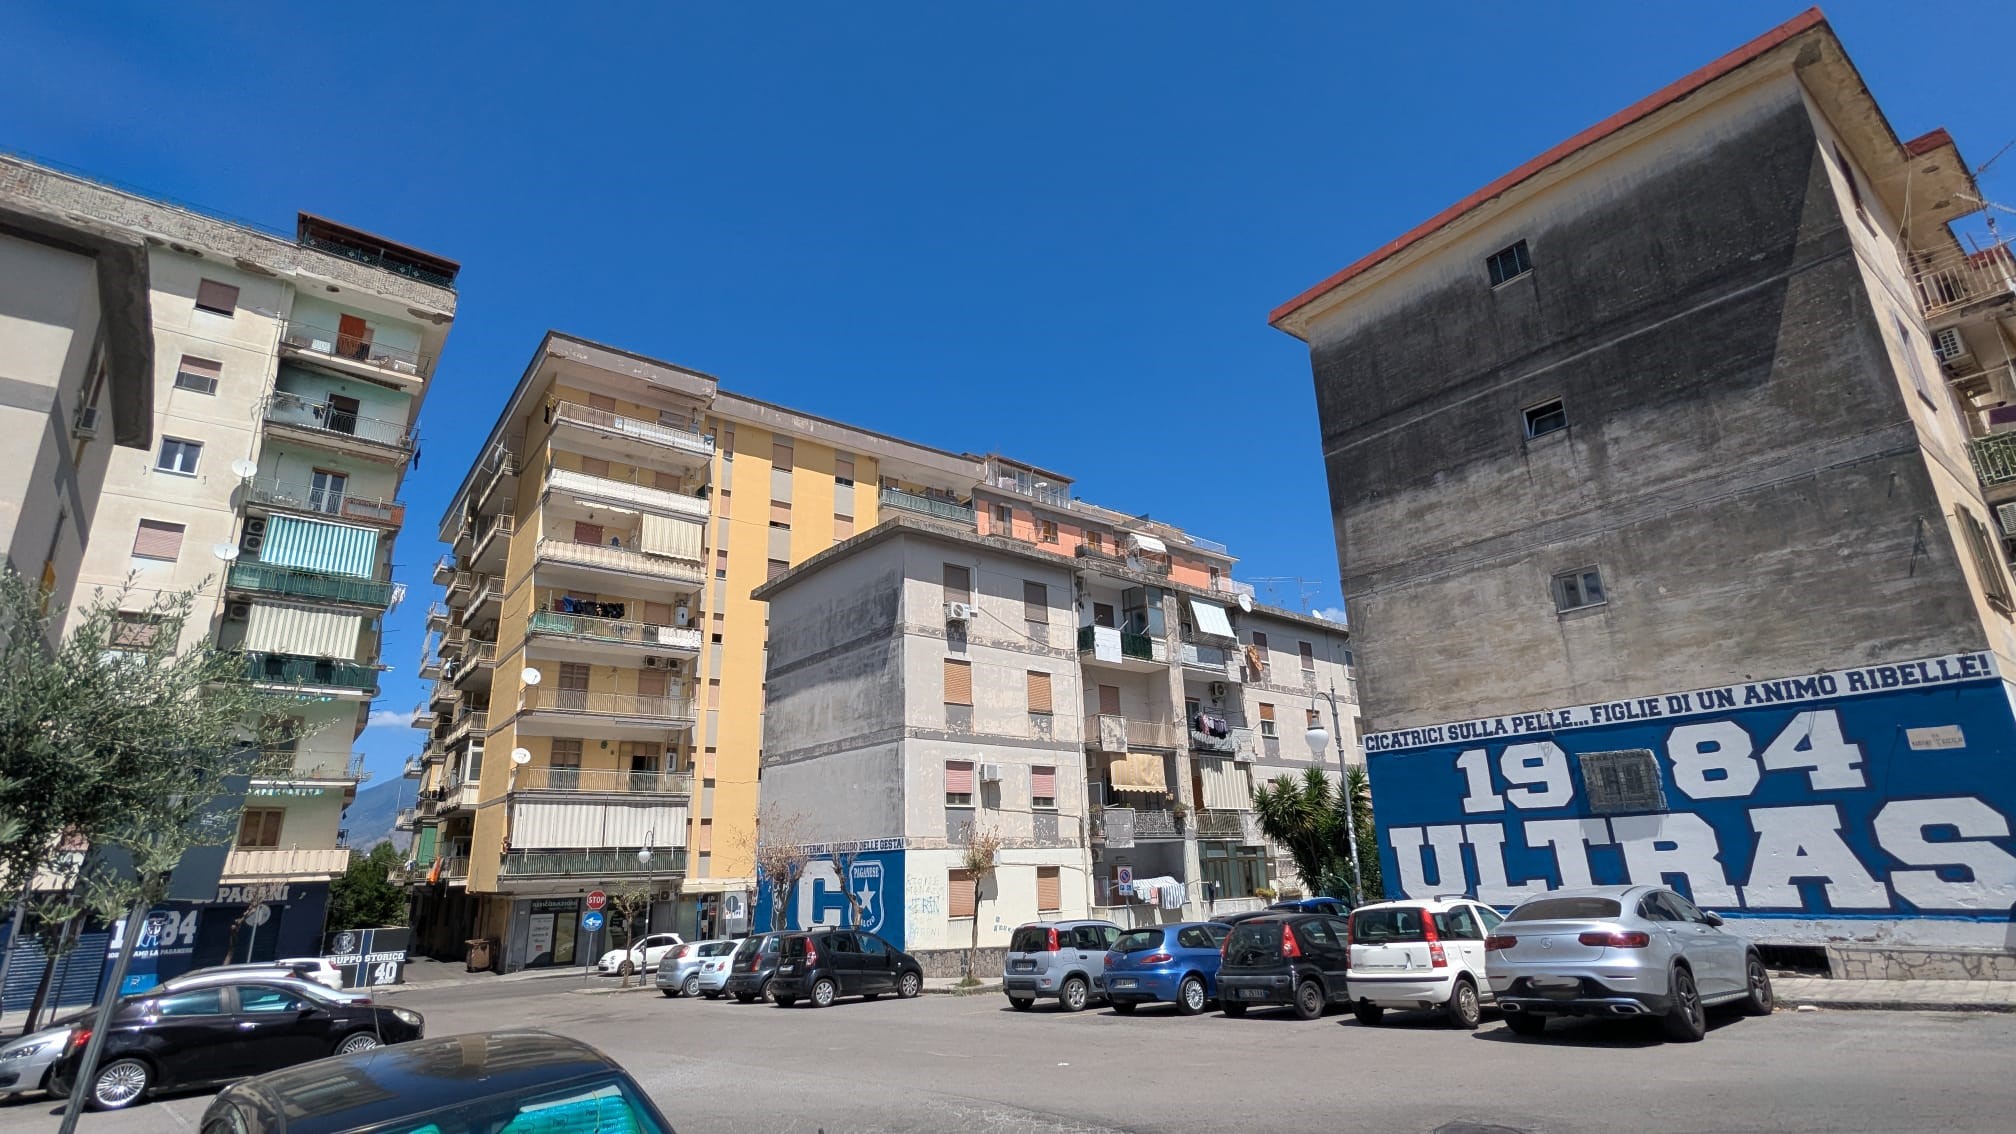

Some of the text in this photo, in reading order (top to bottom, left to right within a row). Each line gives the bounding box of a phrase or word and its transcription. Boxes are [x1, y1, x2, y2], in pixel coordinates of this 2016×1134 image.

[1365, 727, 1444, 750] CICATRICI
[1449, 719, 1508, 740] SULLA
[1592, 698, 1662, 724] FIGLIE
[1666, 694, 1691, 715] DI
[1696, 687, 1737, 711] UN
[1744, 674, 1837, 705] ANIMO
[1845, 654, 1993, 692] RIBELLE!
[859, 840, 879, 851] DELLE
[879, 838, 904, 850] GESTA!
[1389, 796, 2016, 909] ULTRAS
[853, 866, 880, 878] PAGANESE
[217, 885, 290, 904] PAGANI
[588, 896, 605, 905] STOP
[330, 952, 404, 965] RUPPO STORICO
[375, 961, 397, 981] 40
